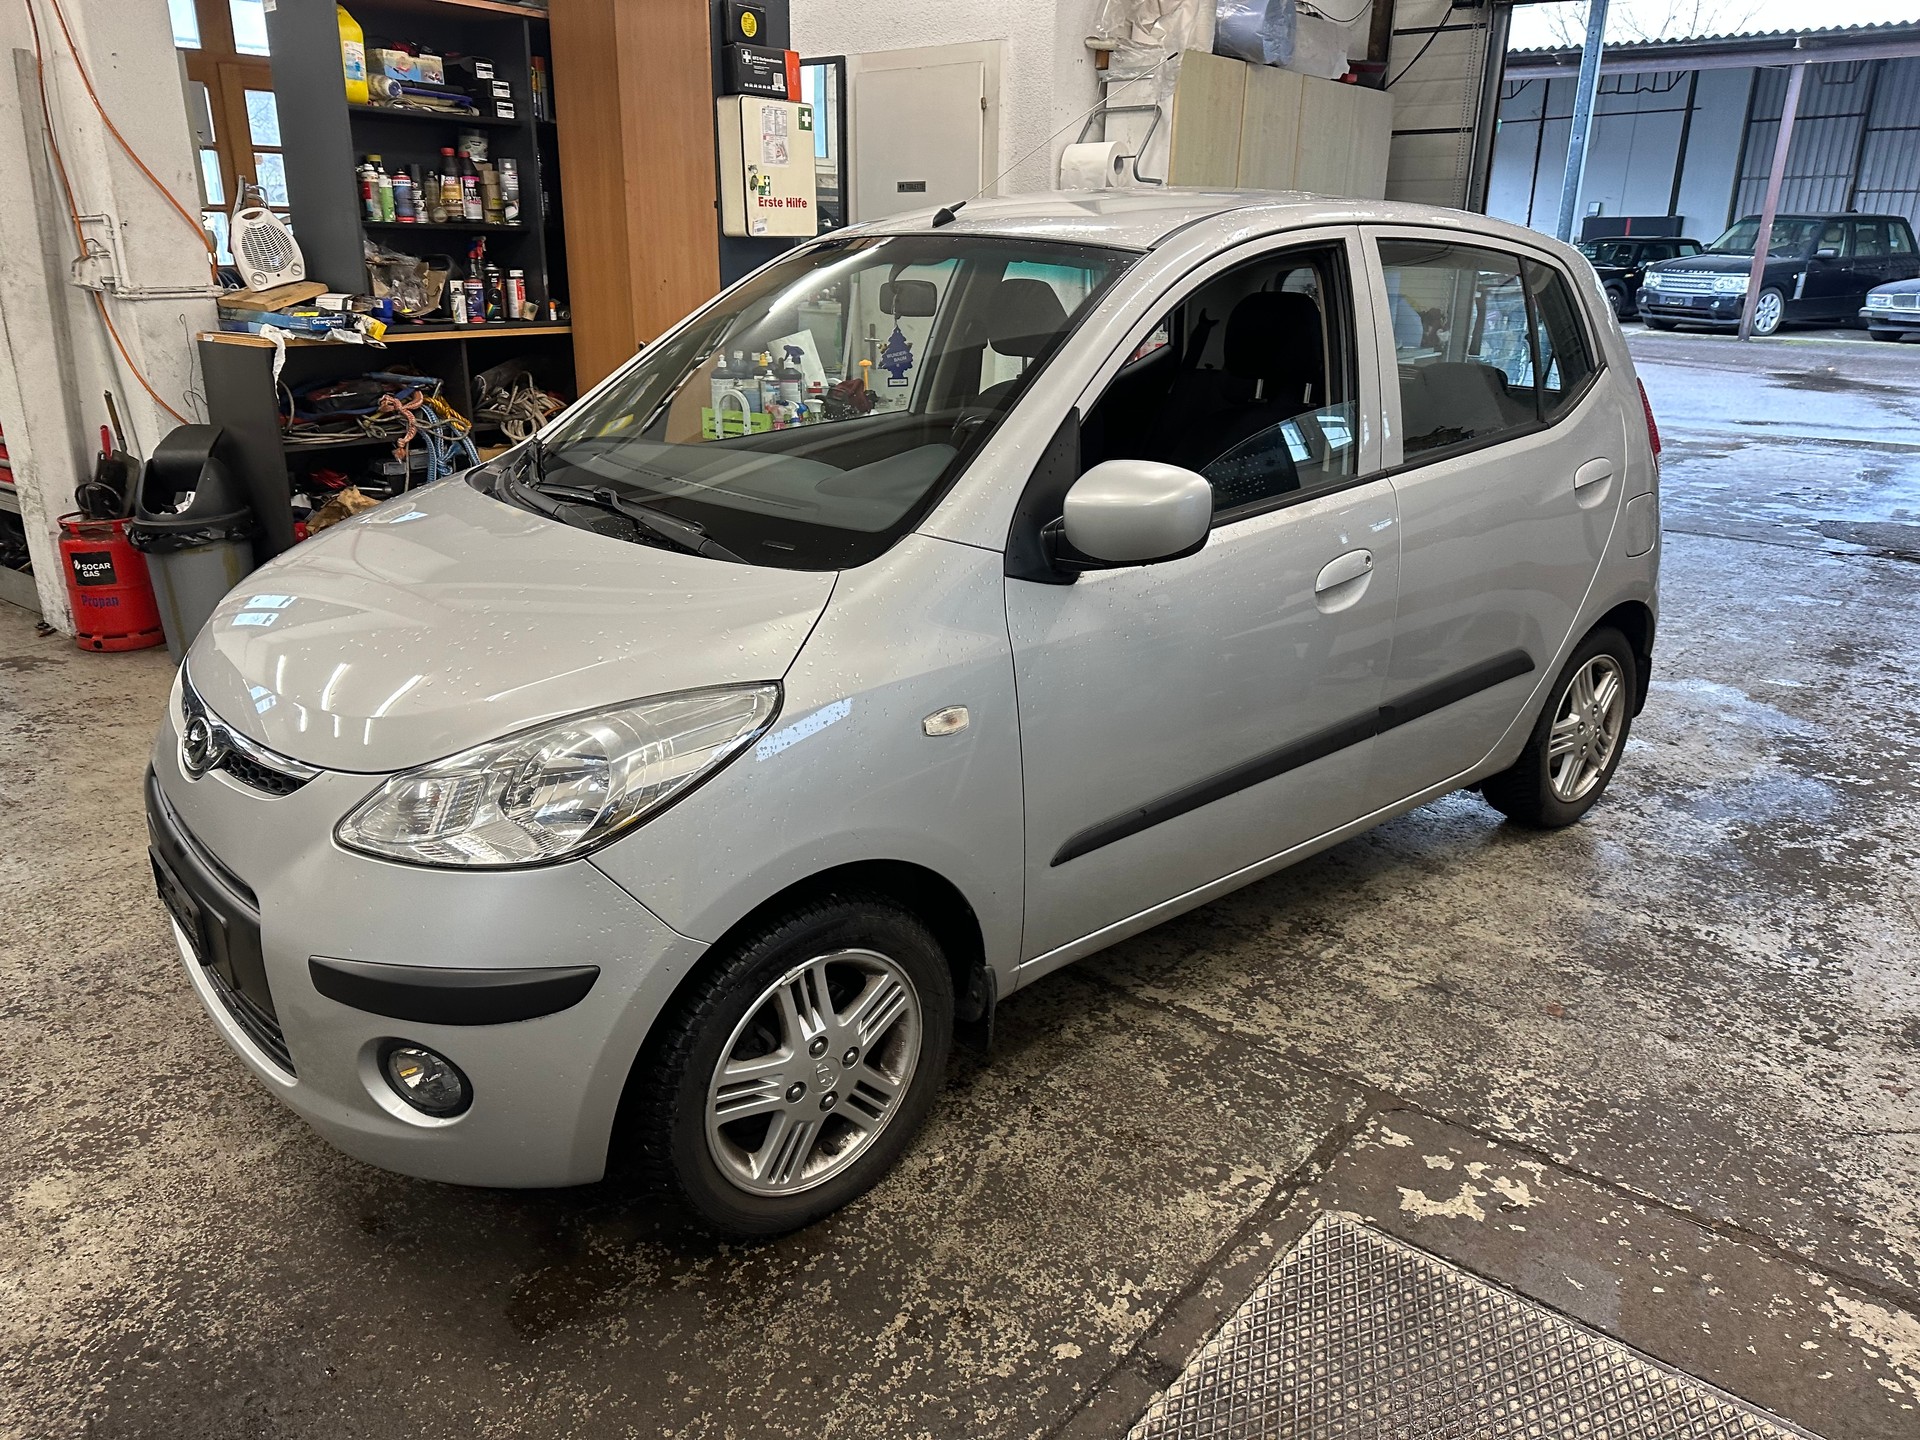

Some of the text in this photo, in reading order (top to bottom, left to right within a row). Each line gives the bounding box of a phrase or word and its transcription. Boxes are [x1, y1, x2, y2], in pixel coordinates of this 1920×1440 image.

[758, 197, 807, 208] Erste Hilfe
[81, 562, 111, 571] SOCAR
[81, 594, 119, 608] Propan
